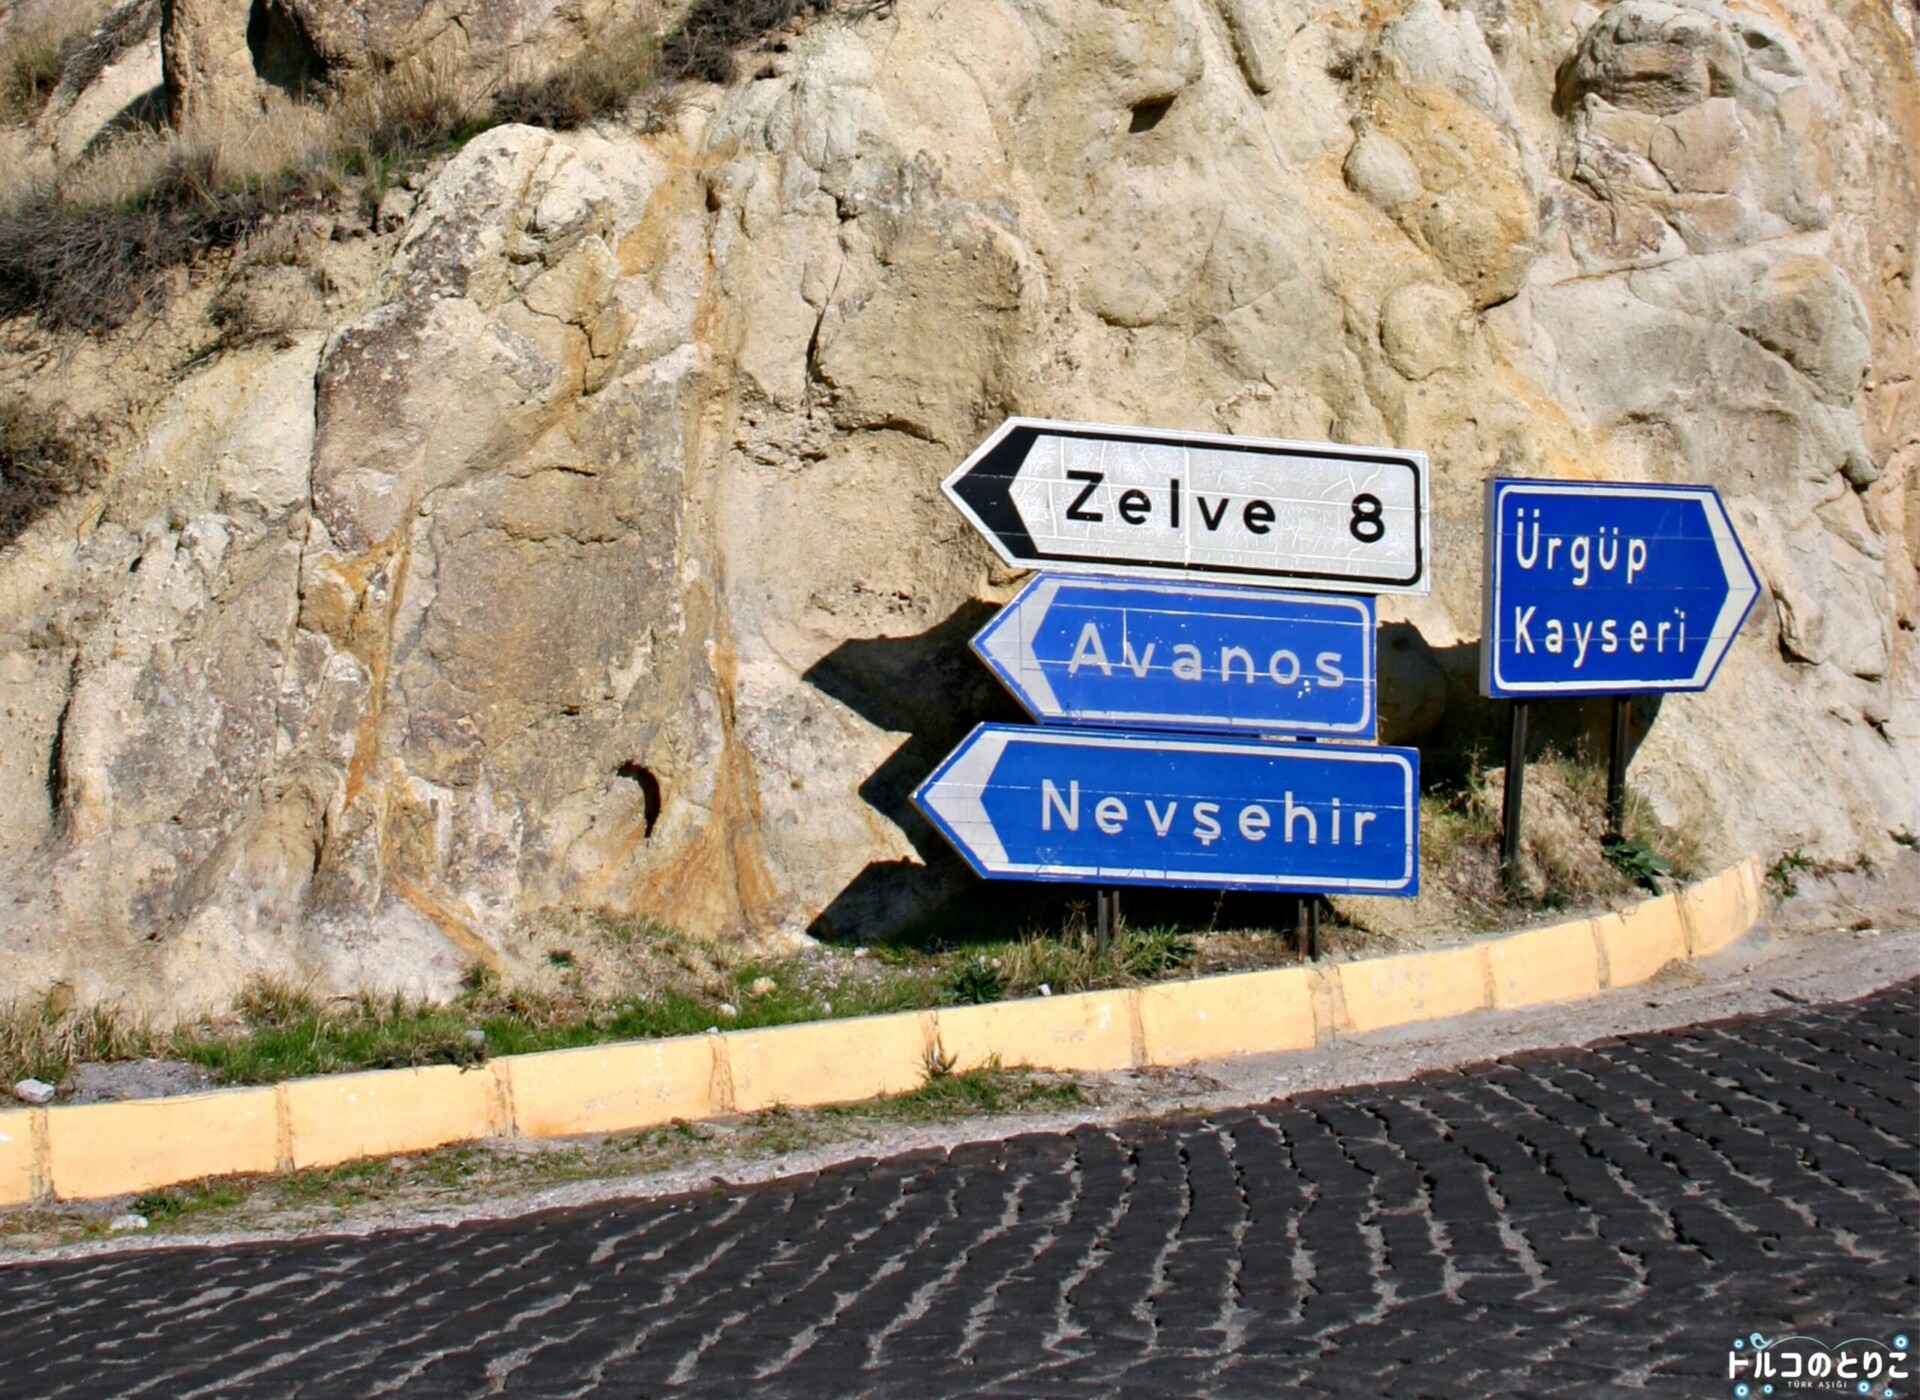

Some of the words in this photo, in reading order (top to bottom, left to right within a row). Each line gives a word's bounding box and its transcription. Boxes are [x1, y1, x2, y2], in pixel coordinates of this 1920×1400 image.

[1065, 469, 1277, 535] Zelve
[1349, 492, 1386, 544] 8
[1515, 507, 1648, 587] Ürgüp
[1067, 622, 1345, 690] Avanos
[1514, 605, 1686, 669] Kayseri
[1041, 777, 1377, 846] Nevşehir
